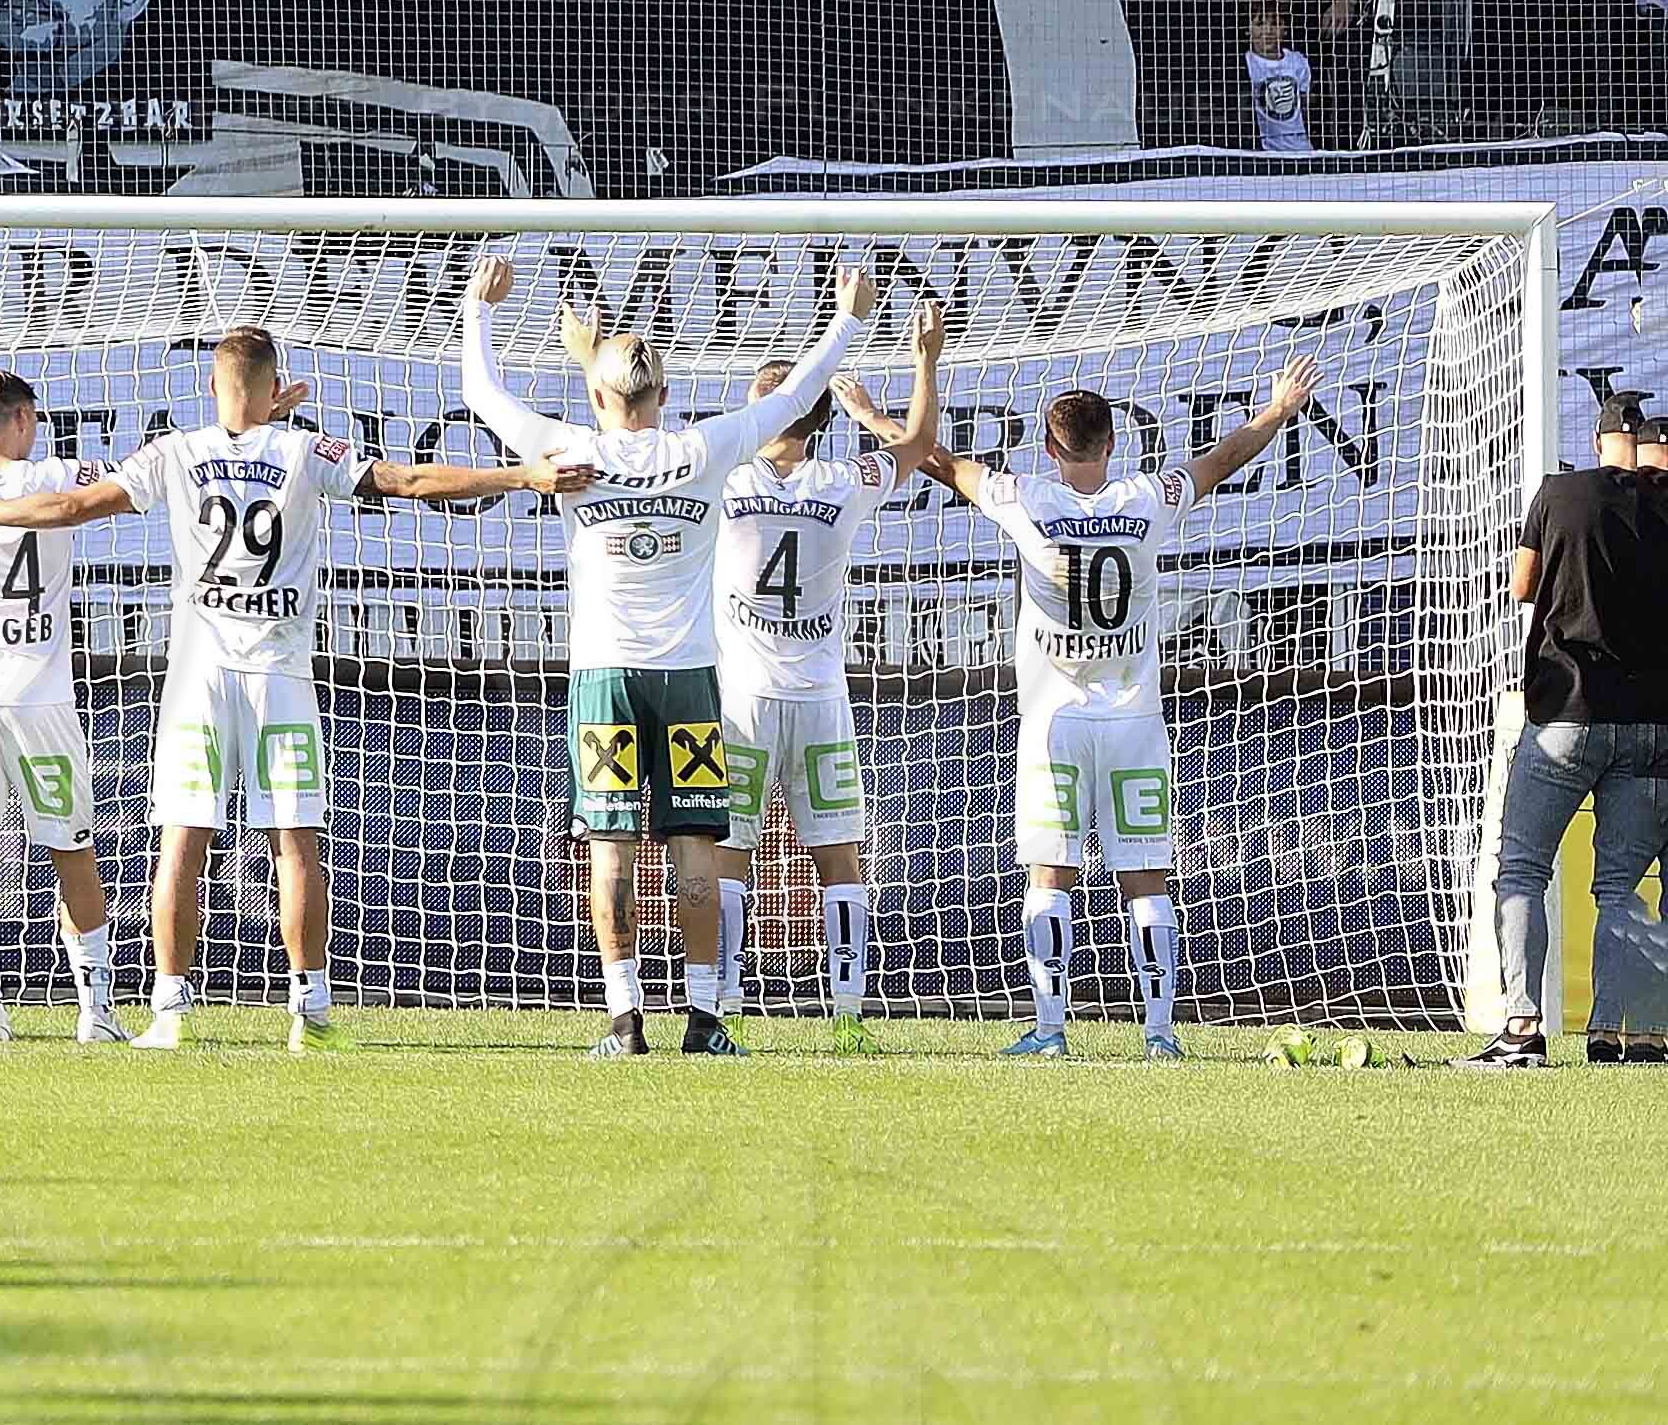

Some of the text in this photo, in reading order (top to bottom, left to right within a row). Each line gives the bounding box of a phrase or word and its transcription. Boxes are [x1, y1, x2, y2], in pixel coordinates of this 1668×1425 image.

[198, 495, 284, 587] 29
[580, 496, 708, 526] PUNTIGAMER
[725, 498, 841, 525] PUNTIGAMER
[754, 529, 804, 619] 4
[1059, 544, 1131, 631] 10
